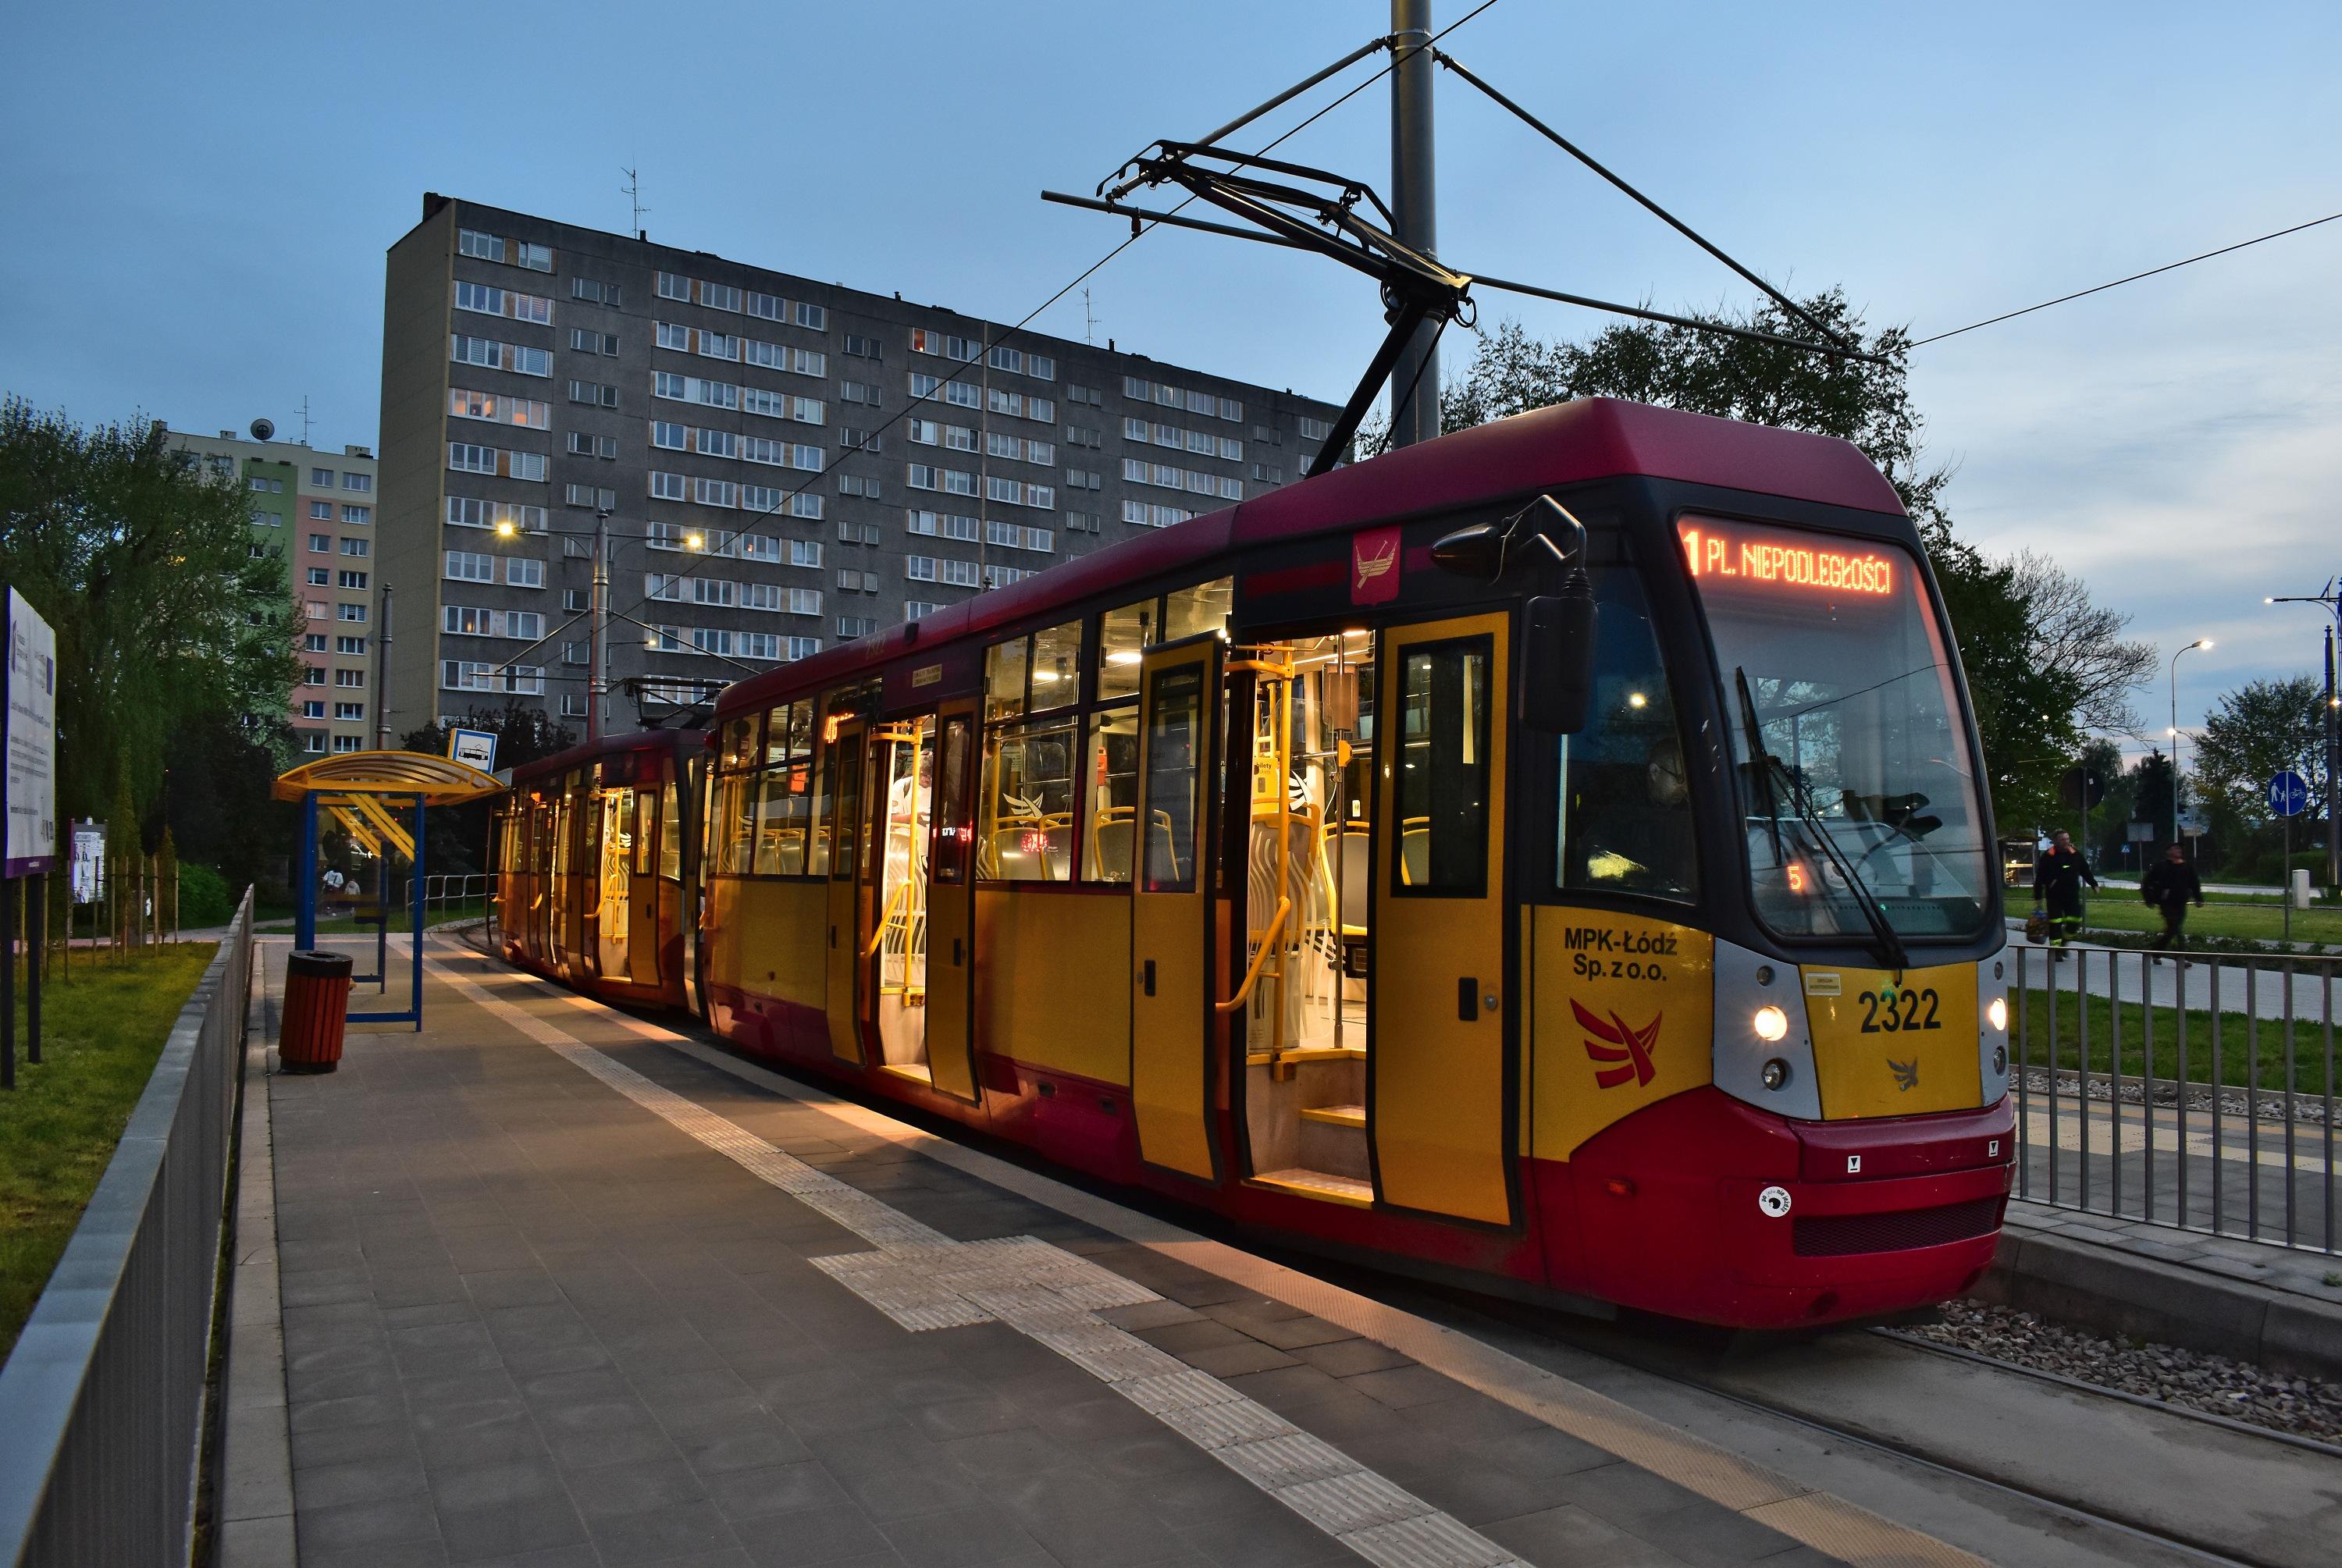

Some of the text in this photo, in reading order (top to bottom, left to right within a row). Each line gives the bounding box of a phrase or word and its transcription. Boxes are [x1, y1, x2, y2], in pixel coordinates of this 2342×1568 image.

[1707, 539, 1736, 574] PL.
[1742, 544, 1891, 594] NIEPODLEGŁOŚCI
[1787, 866, 1802, 890] 5
[1564, 927, 1678, 956] MPK-Łódź
[1573, 952, 1668, 982] Sp. z o.o.
[1859, 988, 1942, 1034] 2322
